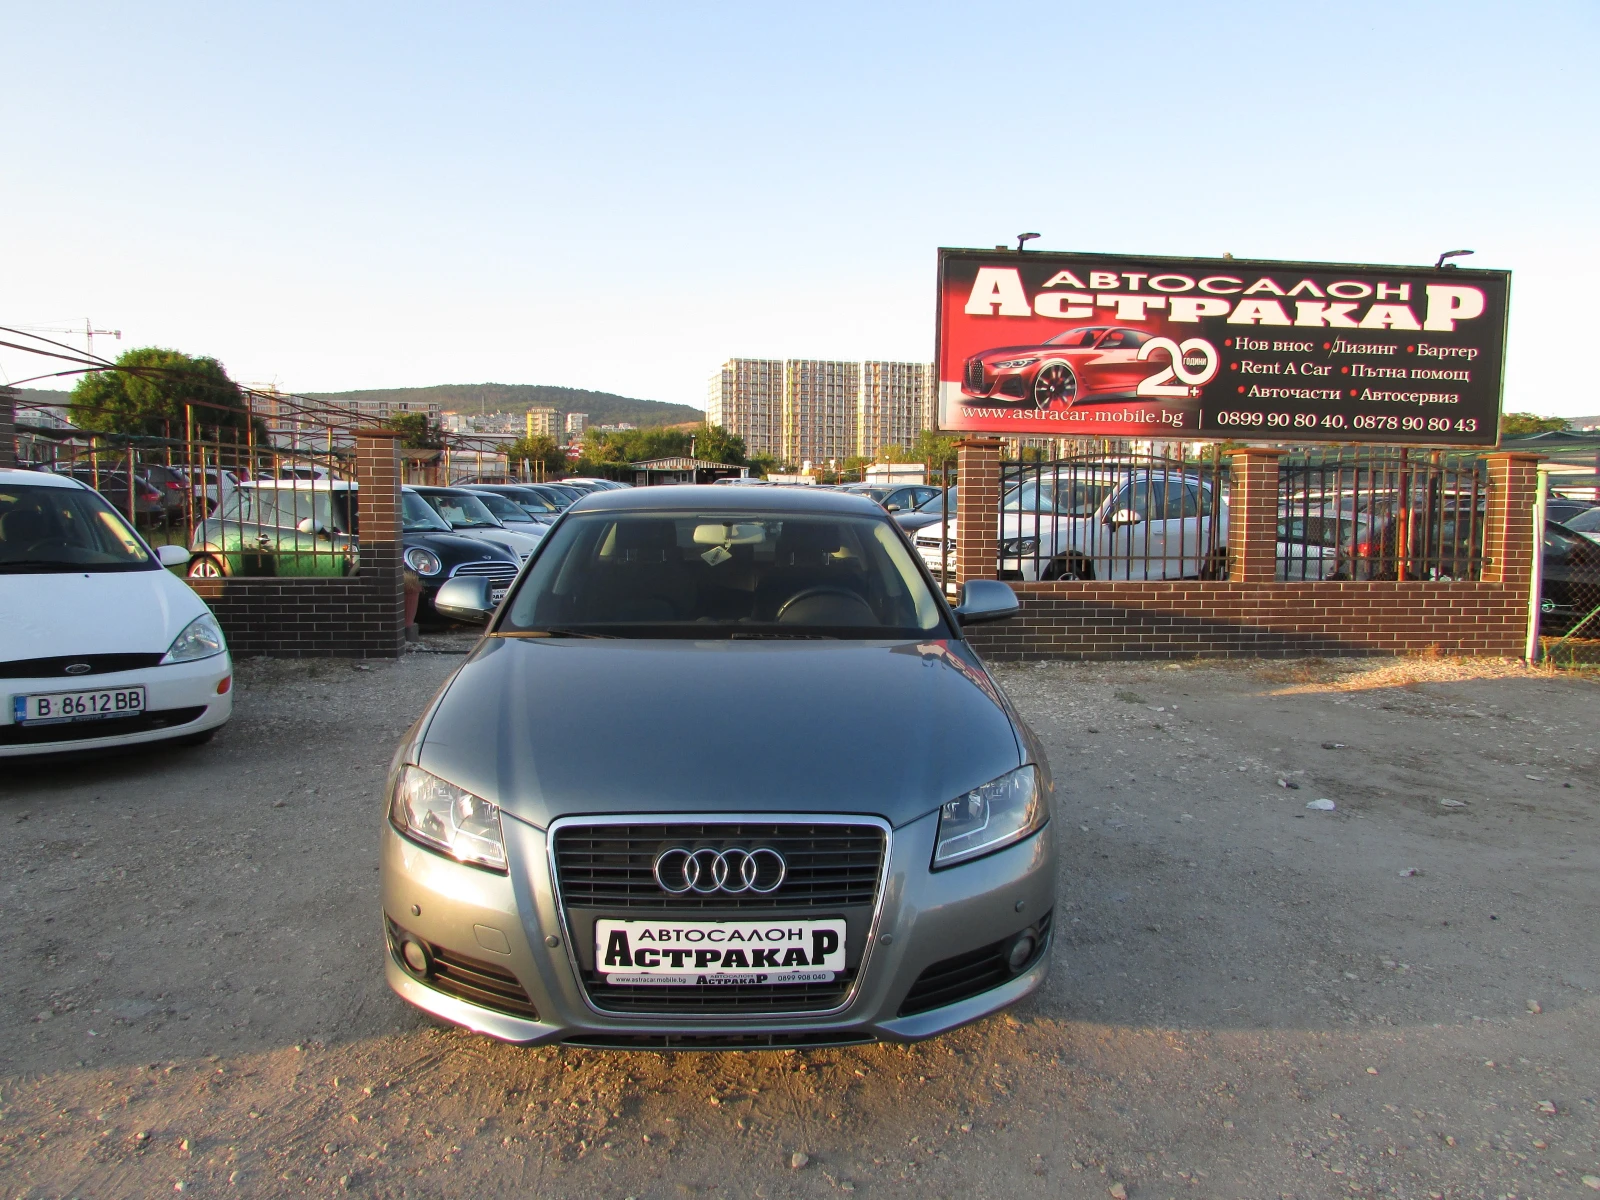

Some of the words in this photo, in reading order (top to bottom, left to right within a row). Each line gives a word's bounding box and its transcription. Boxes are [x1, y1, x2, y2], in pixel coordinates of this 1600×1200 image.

[1042, 270, 1412, 301] АВТОСАЛОН
[1235, 337, 1268, 351] Нов
[1273, 340, 1314, 353] внос
[1333, 340, 1397, 356] Лизинг
[1417, 343, 1478, 361] Бартер
[1183, 356, 1207, 367] ГОДИНИ
[1240, 360, 1281, 375] Rent
[1284, 362, 1297, 375] A
[1300, 362, 1332, 376] Car
[1351, 364, 1407, 379] Пътна
[1411, 368, 1470, 382] помощ
[1247, 384, 1341, 400] Авточасти
[1359, 387, 1458, 406] Автосервиз
[961, 406, 1183, 427] www.astracar.mobile.bg
[1217, 411, 1263, 426] 0899
[1267, 412, 1290, 427] 90
[1294, 413, 1317, 428] 80
[1321, 414, 1348, 430] 40,
[1353, 415, 1398, 430] 0878
[1401, 416, 1424, 431] 90
[1427, 417, 1450, 432] 80
[1453, 418, 1477, 432] 43
[62, 693, 111, 715] 8612
[638, 927, 803, 943] АВТОСАЛОН
[615, 976, 687, 984] www.astracar.mobile.bg
[777, 974, 795, 982] 0899
[812, 973, 827, 981] 040
